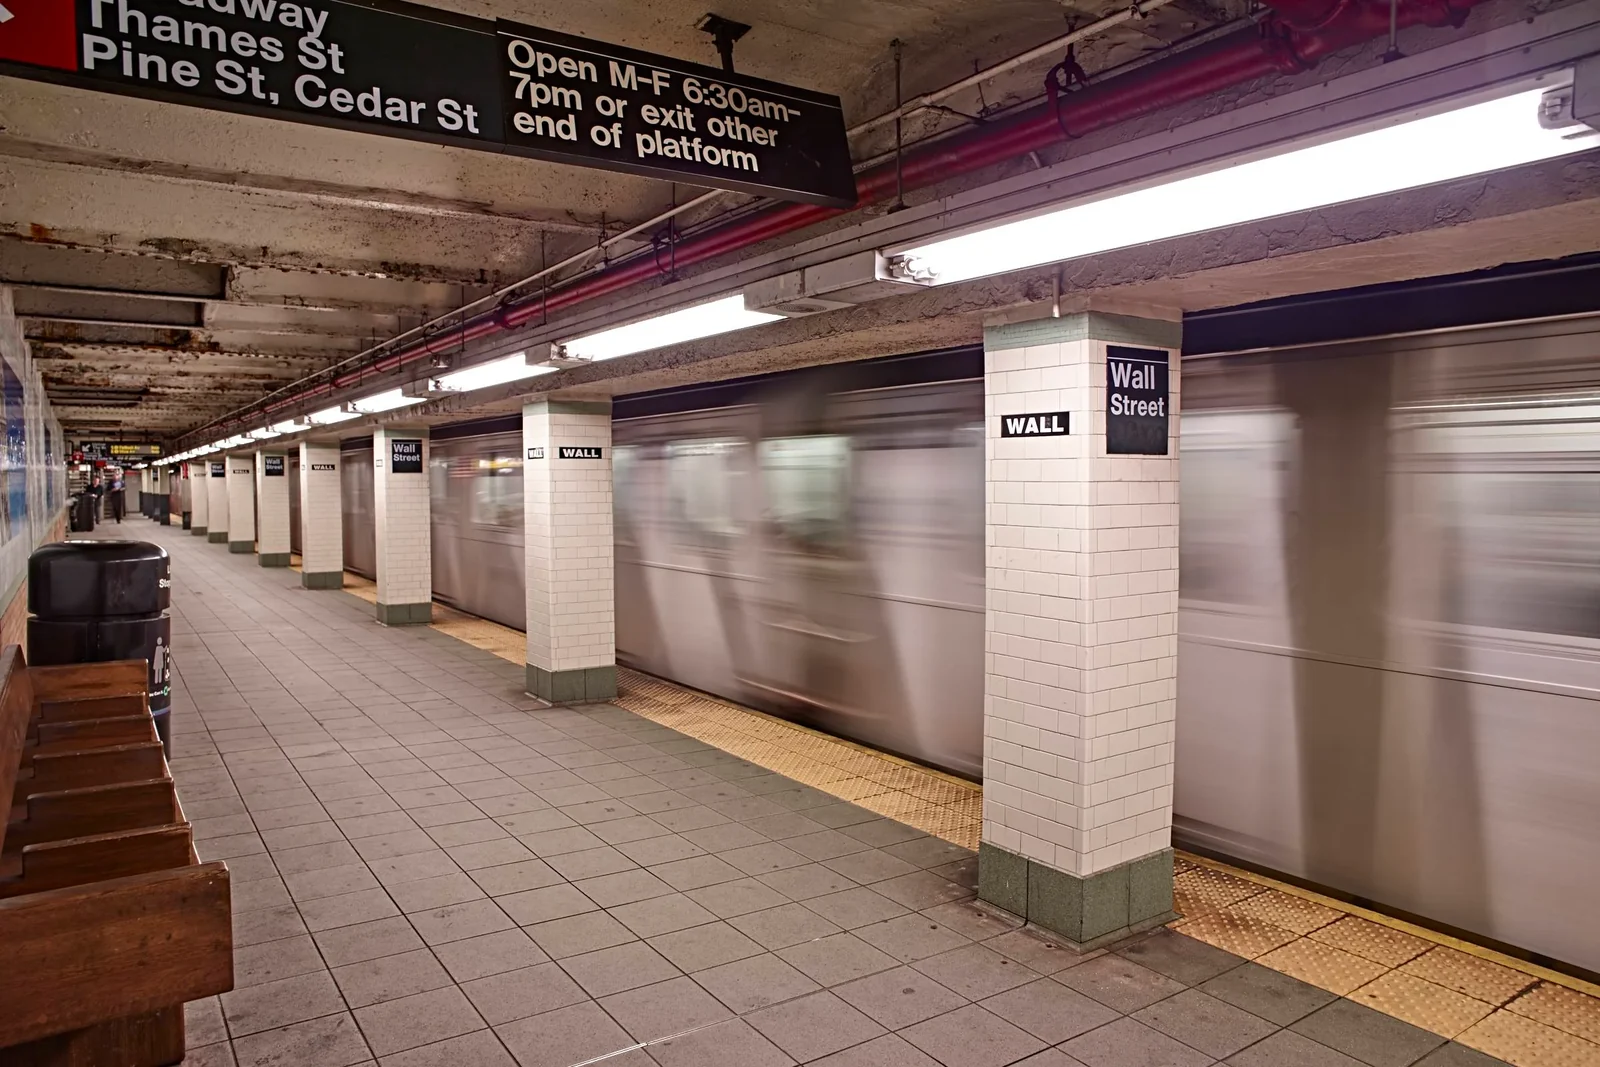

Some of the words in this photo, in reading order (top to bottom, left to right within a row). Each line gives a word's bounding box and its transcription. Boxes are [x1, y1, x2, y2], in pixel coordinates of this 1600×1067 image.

[90, 0, 285, 62] Thames
[297, 36, 345, 75] St
[507, 39, 598, 83] Open
[82, 33, 199, 87] Pine
[215, 59, 280, 105] St,
[294, 74, 427, 125] Cedar
[436, 98, 480, 134] St
[509, 71, 583, 111] 7pm
[595, 95, 628, 119] or
[640, 103, 697, 132] exit
[707, 117, 778, 147] other
[513, 111, 578, 142] end
[590, 122, 623, 149] of
[635, 129, 759, 172] platform
[1110, 361, 1155, 390] Wall
[1110, 393, 1165, 417] Street
[1006, 415, 1065, 435] WALL
[393, 444, 416, 453] Wall
[393, 453, 421, 462] Street
[562, 448, 599, 458] WALL
